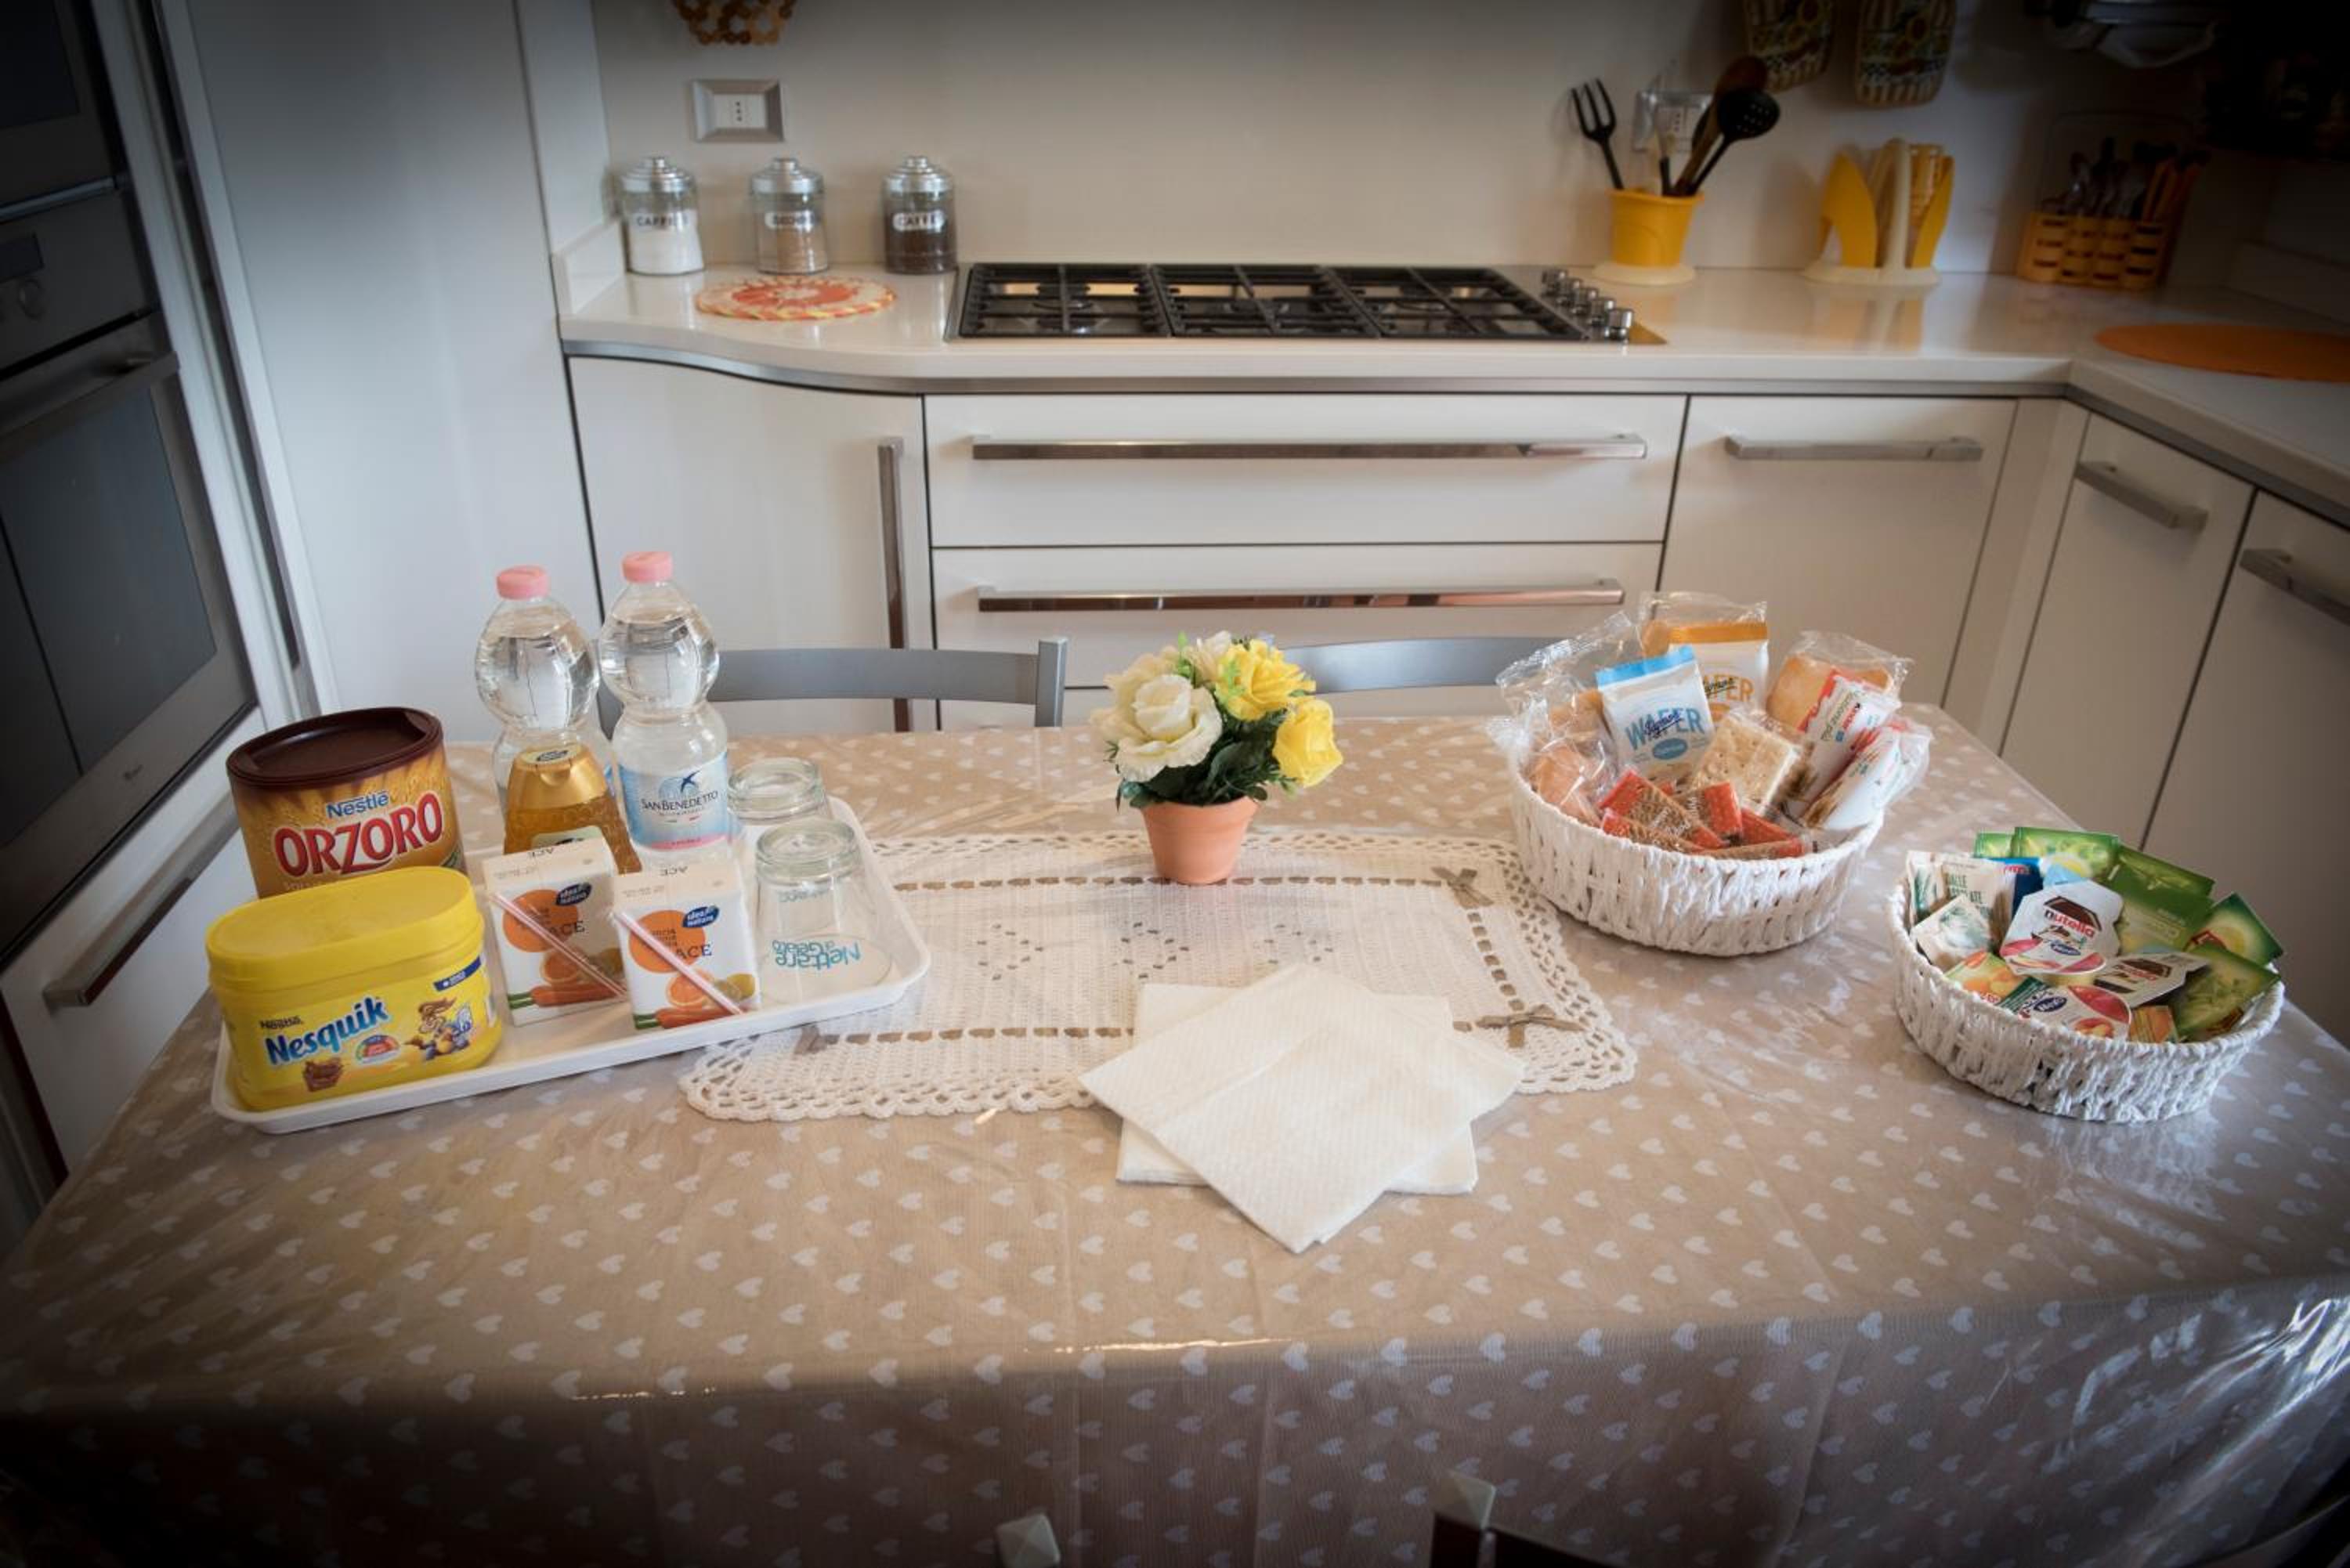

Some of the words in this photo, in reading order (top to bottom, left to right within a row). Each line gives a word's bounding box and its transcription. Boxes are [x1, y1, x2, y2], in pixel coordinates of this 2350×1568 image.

[1625, 707, 1705, 751] WAFER
[273, 791, 444, 877] ORZORO
[2044, 909, 2096, 938] nutella
[265, 997, 389, 1065] Nesquik
